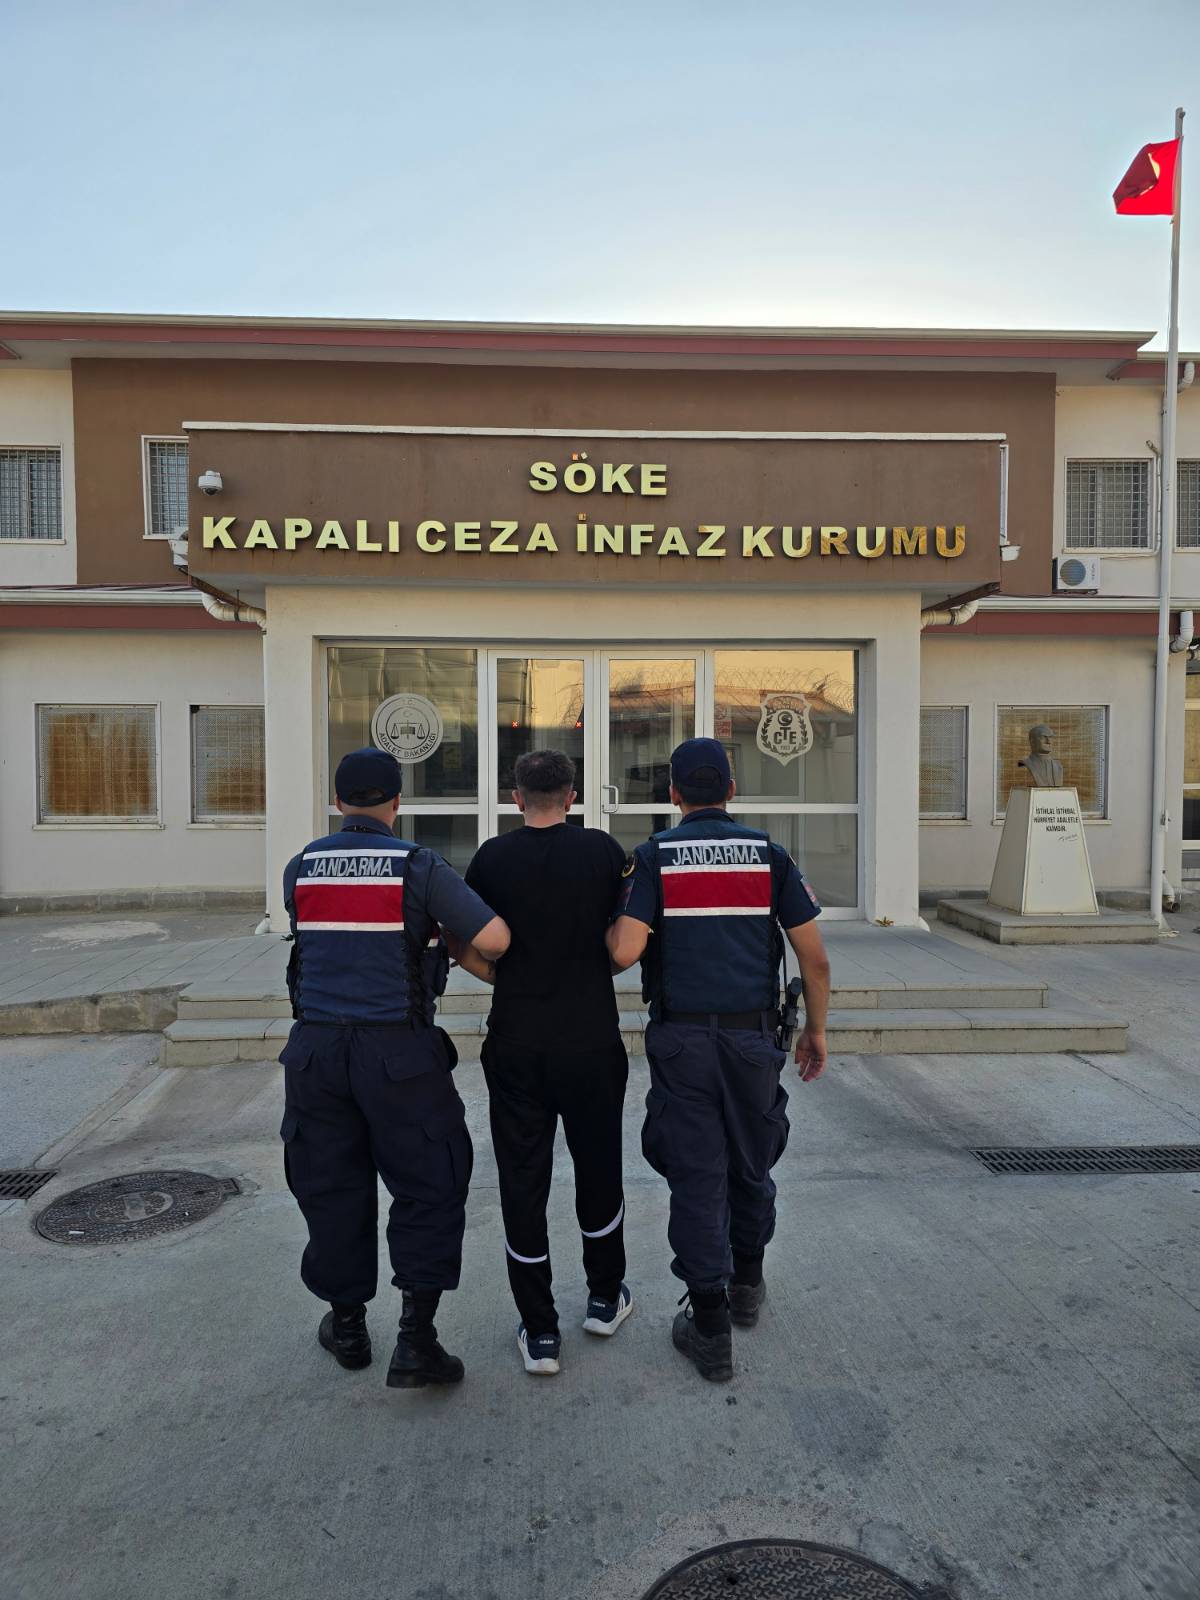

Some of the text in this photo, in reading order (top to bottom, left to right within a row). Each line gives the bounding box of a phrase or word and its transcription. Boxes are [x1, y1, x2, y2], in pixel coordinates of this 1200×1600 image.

[529, 452, 668, 497] SÖKE
[202, 513, 966, 558] KAPALI CEZA İNFAZ KURUMU
[379, 732, 402, 755] ADALET
[774, 727, 797, 745] CTE
[307, 856, 393, 877] JANDARMA
[671, 845, 762, 866] JANDARMA
